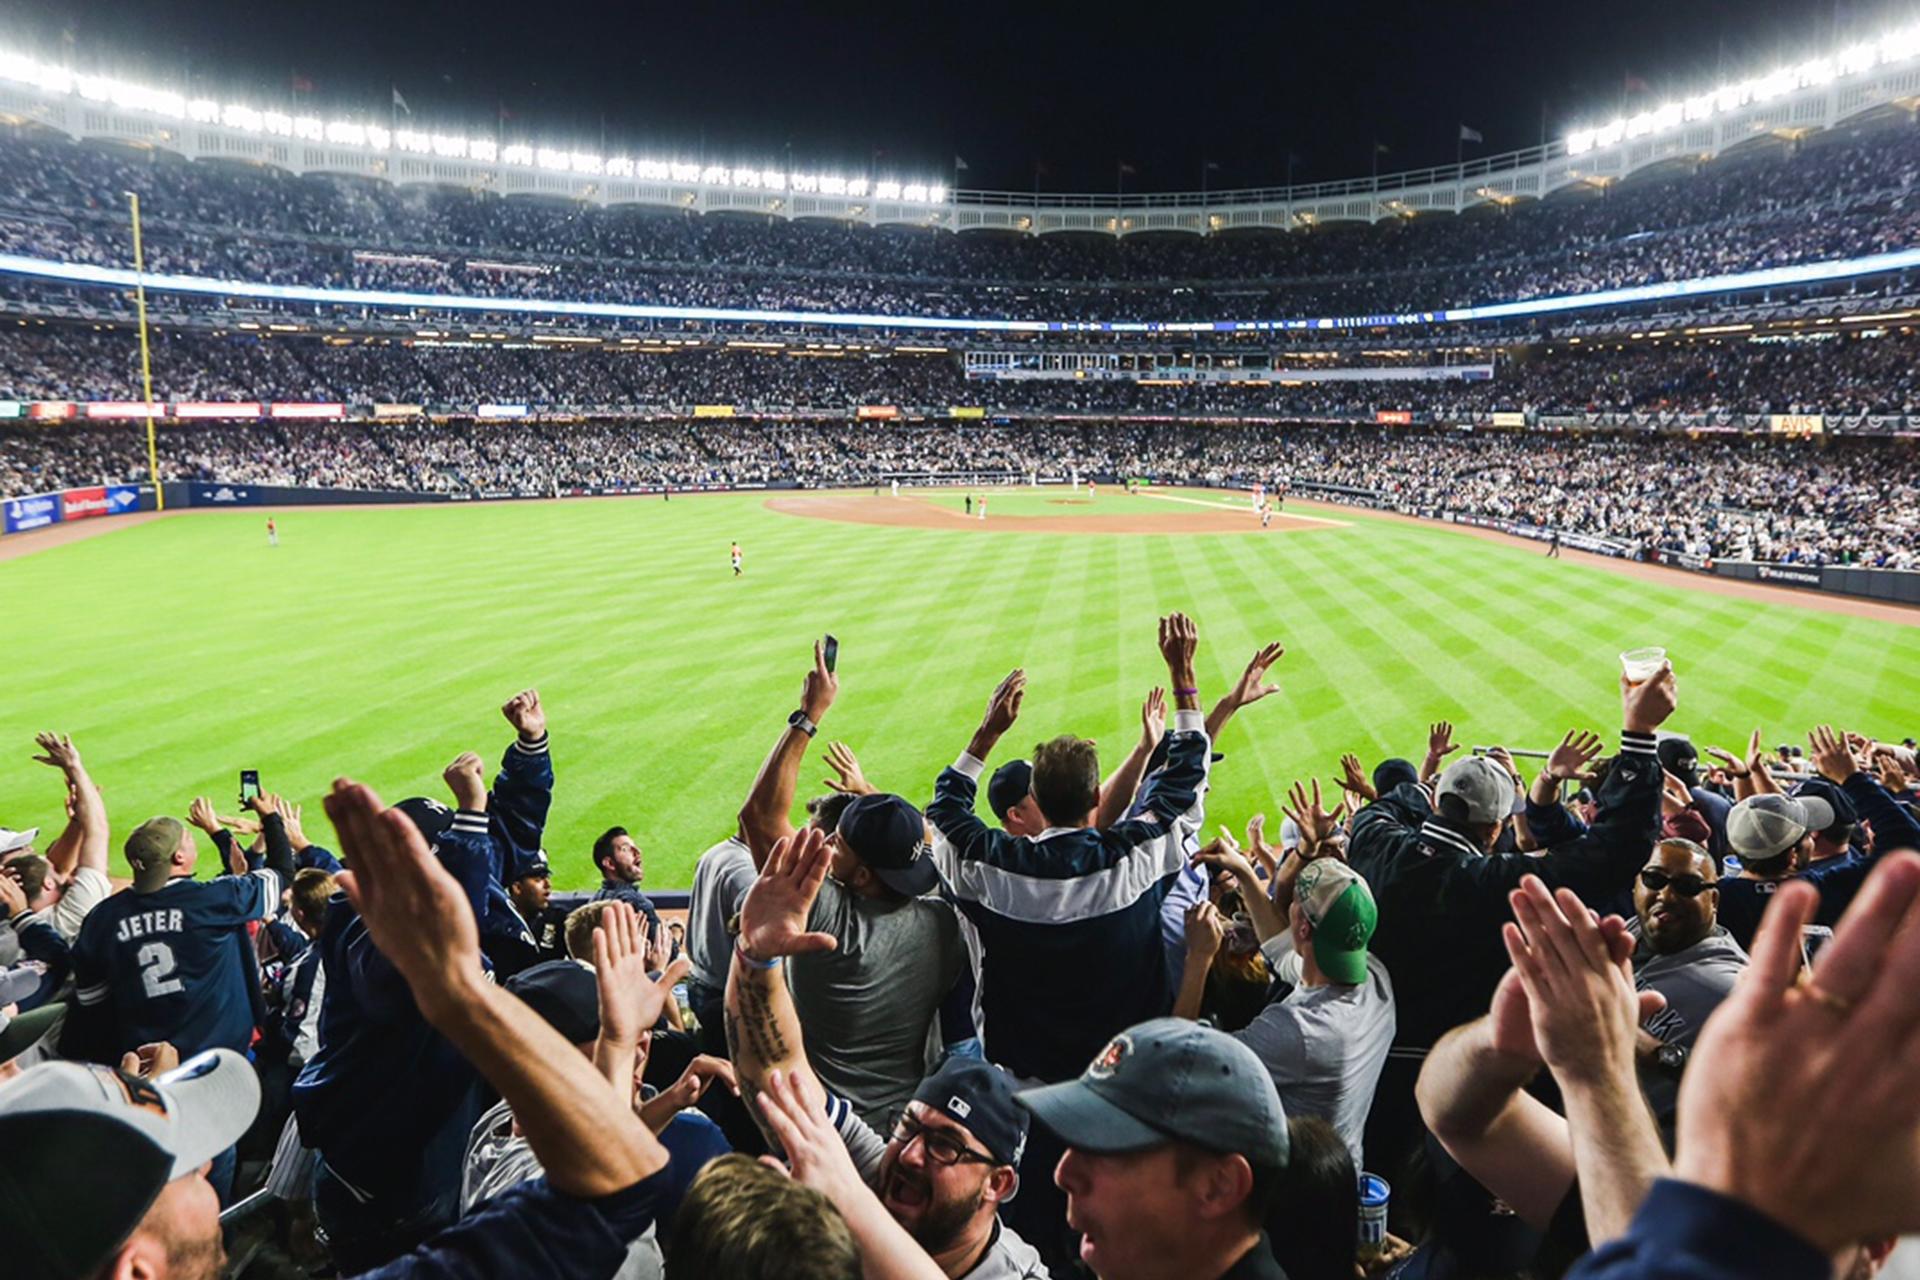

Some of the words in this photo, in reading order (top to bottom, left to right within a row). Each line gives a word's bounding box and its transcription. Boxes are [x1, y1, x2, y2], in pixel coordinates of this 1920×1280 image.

[1780, 416, 1813, 431] AVIS
[116, 908, 184, 943] JETER
[137, 941, 186, 999] 2
